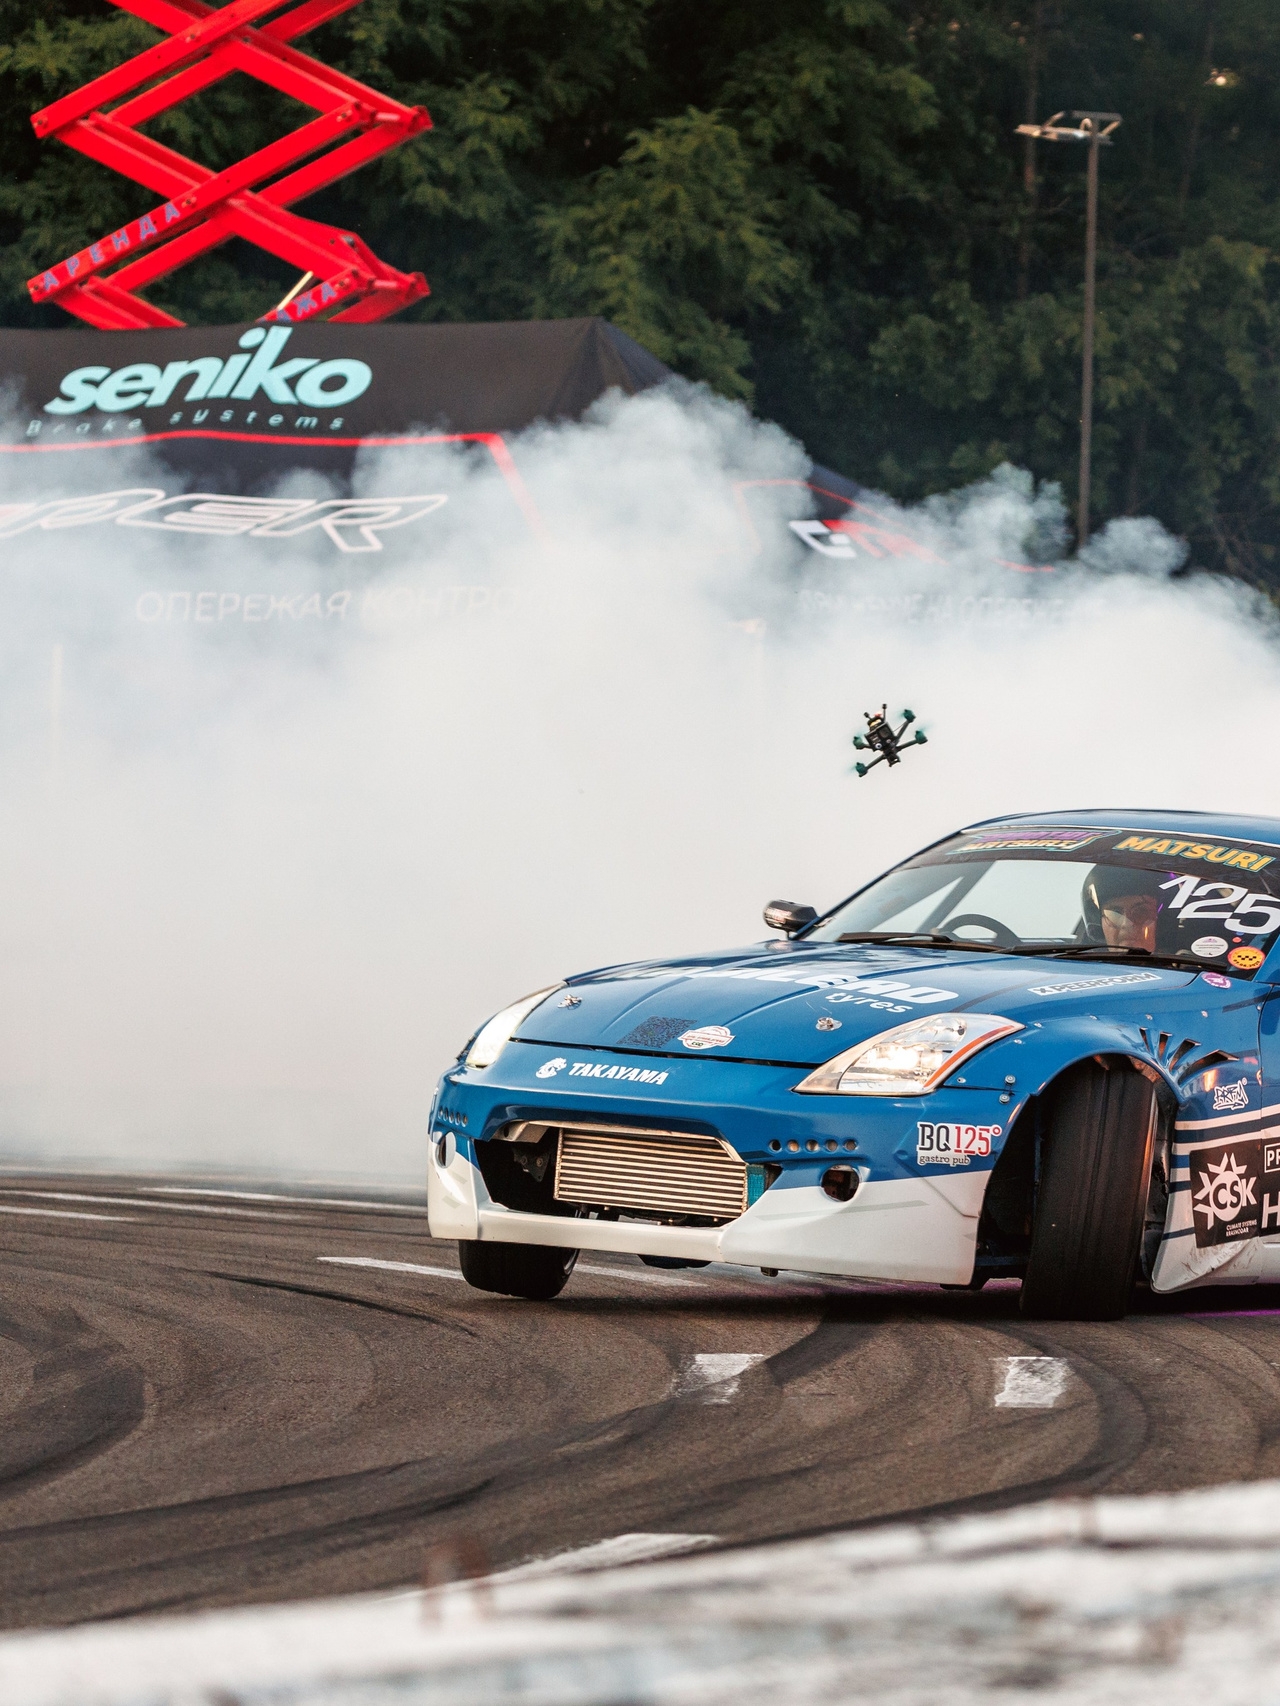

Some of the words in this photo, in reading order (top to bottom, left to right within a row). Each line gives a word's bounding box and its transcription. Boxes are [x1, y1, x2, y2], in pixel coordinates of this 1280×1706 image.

[42, 203, 181, 291] АРЕНДА
[259, 283, 337, 322] АЖА
[43, 325, 373, 415] seniko
[169, 408, 345, 431] systems
[135, 589, 352, 624] ОПЕРЕЖАЯ
[1113, 835, 1276, 872] MATSURI
[825, 991, 914, 1014] tyres
[568, 1062, 669, 1085] TAKAYAMA
[918, 1123, 951, 1152] BQ
[919, 1155, 950, 1165] gastro
[952, 1155, 970, 1166] pub
[1212, 1176, 1258, 1211] CSK
